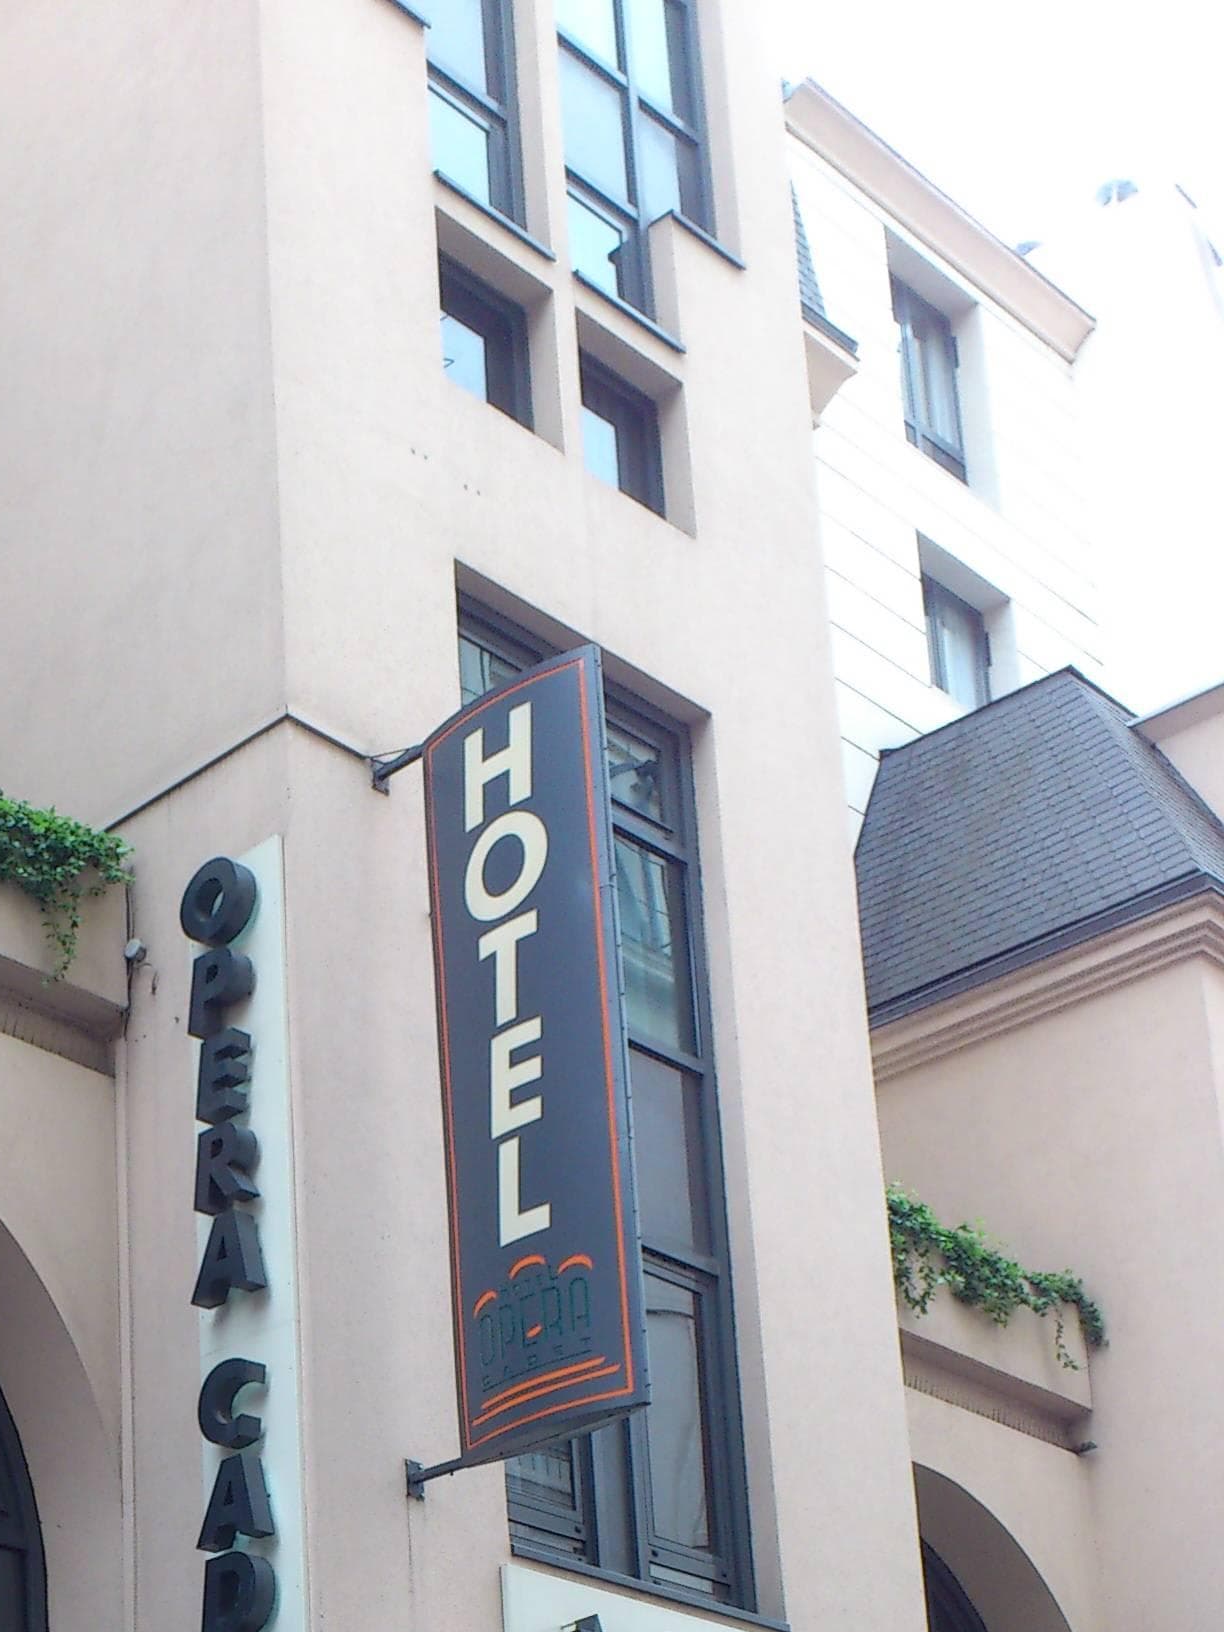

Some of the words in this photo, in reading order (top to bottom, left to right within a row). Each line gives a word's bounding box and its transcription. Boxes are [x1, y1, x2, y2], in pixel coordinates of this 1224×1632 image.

[180, 856, 267, 1310] OPERA
[463, 700, 552, 1248] HOTEL
[479, 1276, 591, 1366] OPERA
